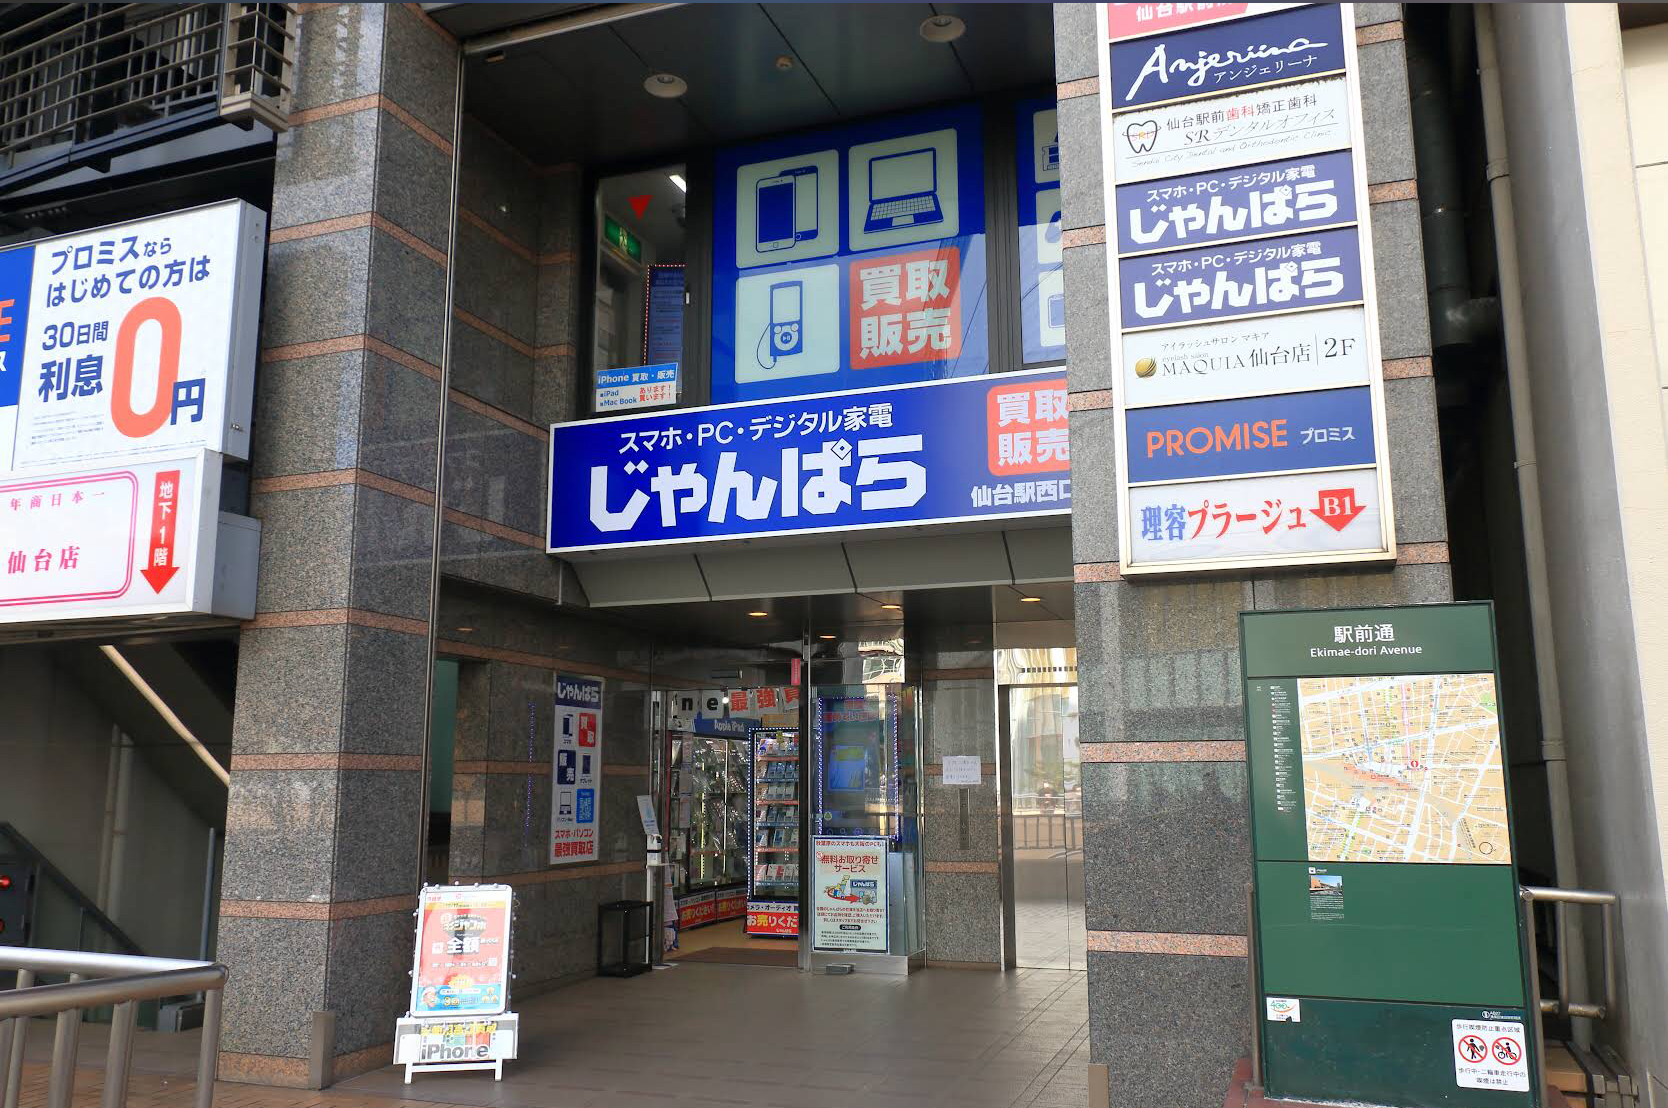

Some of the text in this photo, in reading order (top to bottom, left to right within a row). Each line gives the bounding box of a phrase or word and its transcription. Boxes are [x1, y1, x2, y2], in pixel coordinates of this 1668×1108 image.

[1213, 55, 1317, 84] アンジェリーナ
[1167, 93, 1317, 131] 仙台駅前歯科矯正歯科
[1146, 164, 1315, 202] スマホ・PC・デジタル家電
[1129, 179, 1338, 244] じゃんぱら
[1151, 241, 1322, 276] スマホ・PC・デジタル家電
[46, 255, 211, 307] はじめての方は
[859, 259, 951, 311] 買取
[1134, 257, 1344, 319] じゃんぱら
[42, 321, 109, 351] 30日間
[859, 308, 952, 360] 販売
[1162, 337, 1356, 376] MAQUIA 仙台店 2F
[38, 354, 104, 403] 利息
[598, 374, 630, 384] iPhone
[618, 402, 893, 454] スマホ・PC・デジタル家電
[1147, 419, 1356, 458] PROMISE プロミス
[589, 434, 927, 532] じゃんぱら
[153, 481, 174, 567] 地下1階
[1141, 496, 1354, 541] 理容プラージュ B1
[7, 546, 81, 574] 仙台店
[1310, 644, 1423, 658] Ekimae-dori Avenue
[1334, 624, 1395, 643] 駅前通
[821, 854, 879, 865] 無料お取り寄せ
[834, 864, 866, 873] サービス
